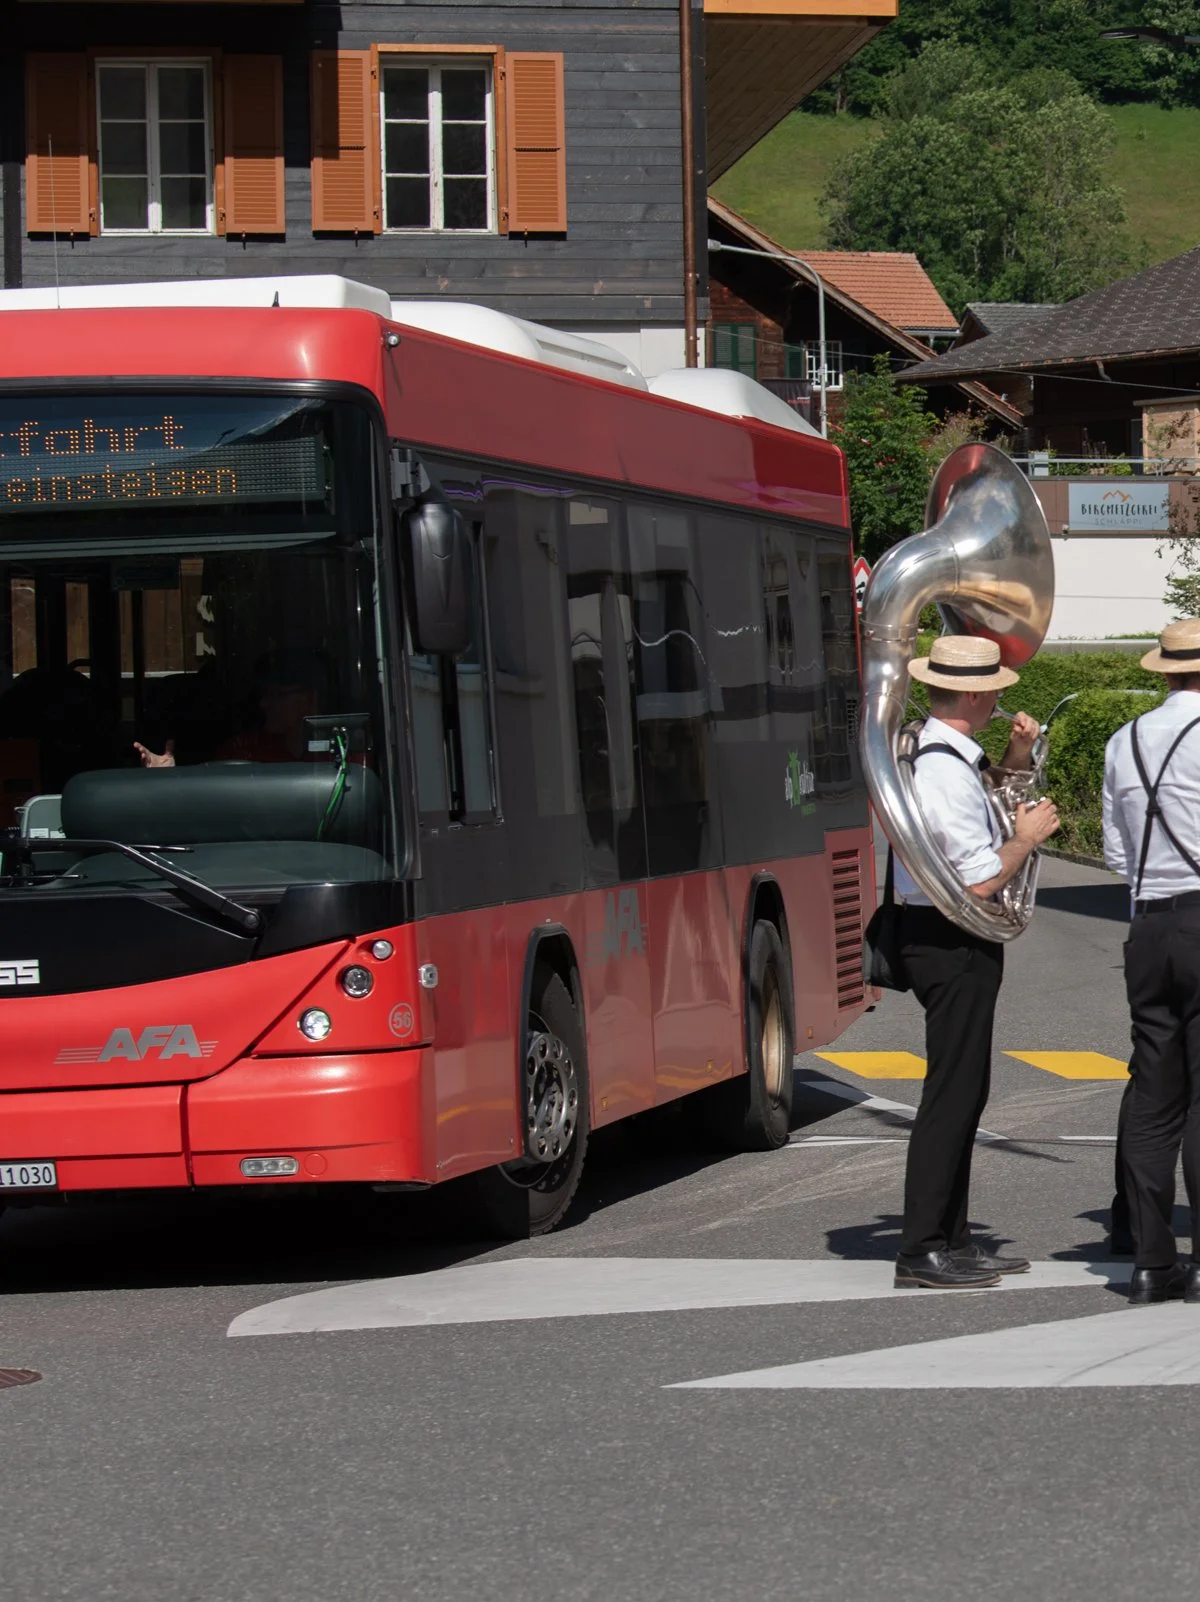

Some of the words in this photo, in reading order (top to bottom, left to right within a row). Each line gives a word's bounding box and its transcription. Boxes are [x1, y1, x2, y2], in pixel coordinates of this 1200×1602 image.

[0, 416, 184, 457] fahrt
[7, 462, 237, 502] einsteigen
[603, 888, 645, 962] AFA
[393, 1011, 411, 1029] 56
[97, 1024, 203, 1062] AFA
